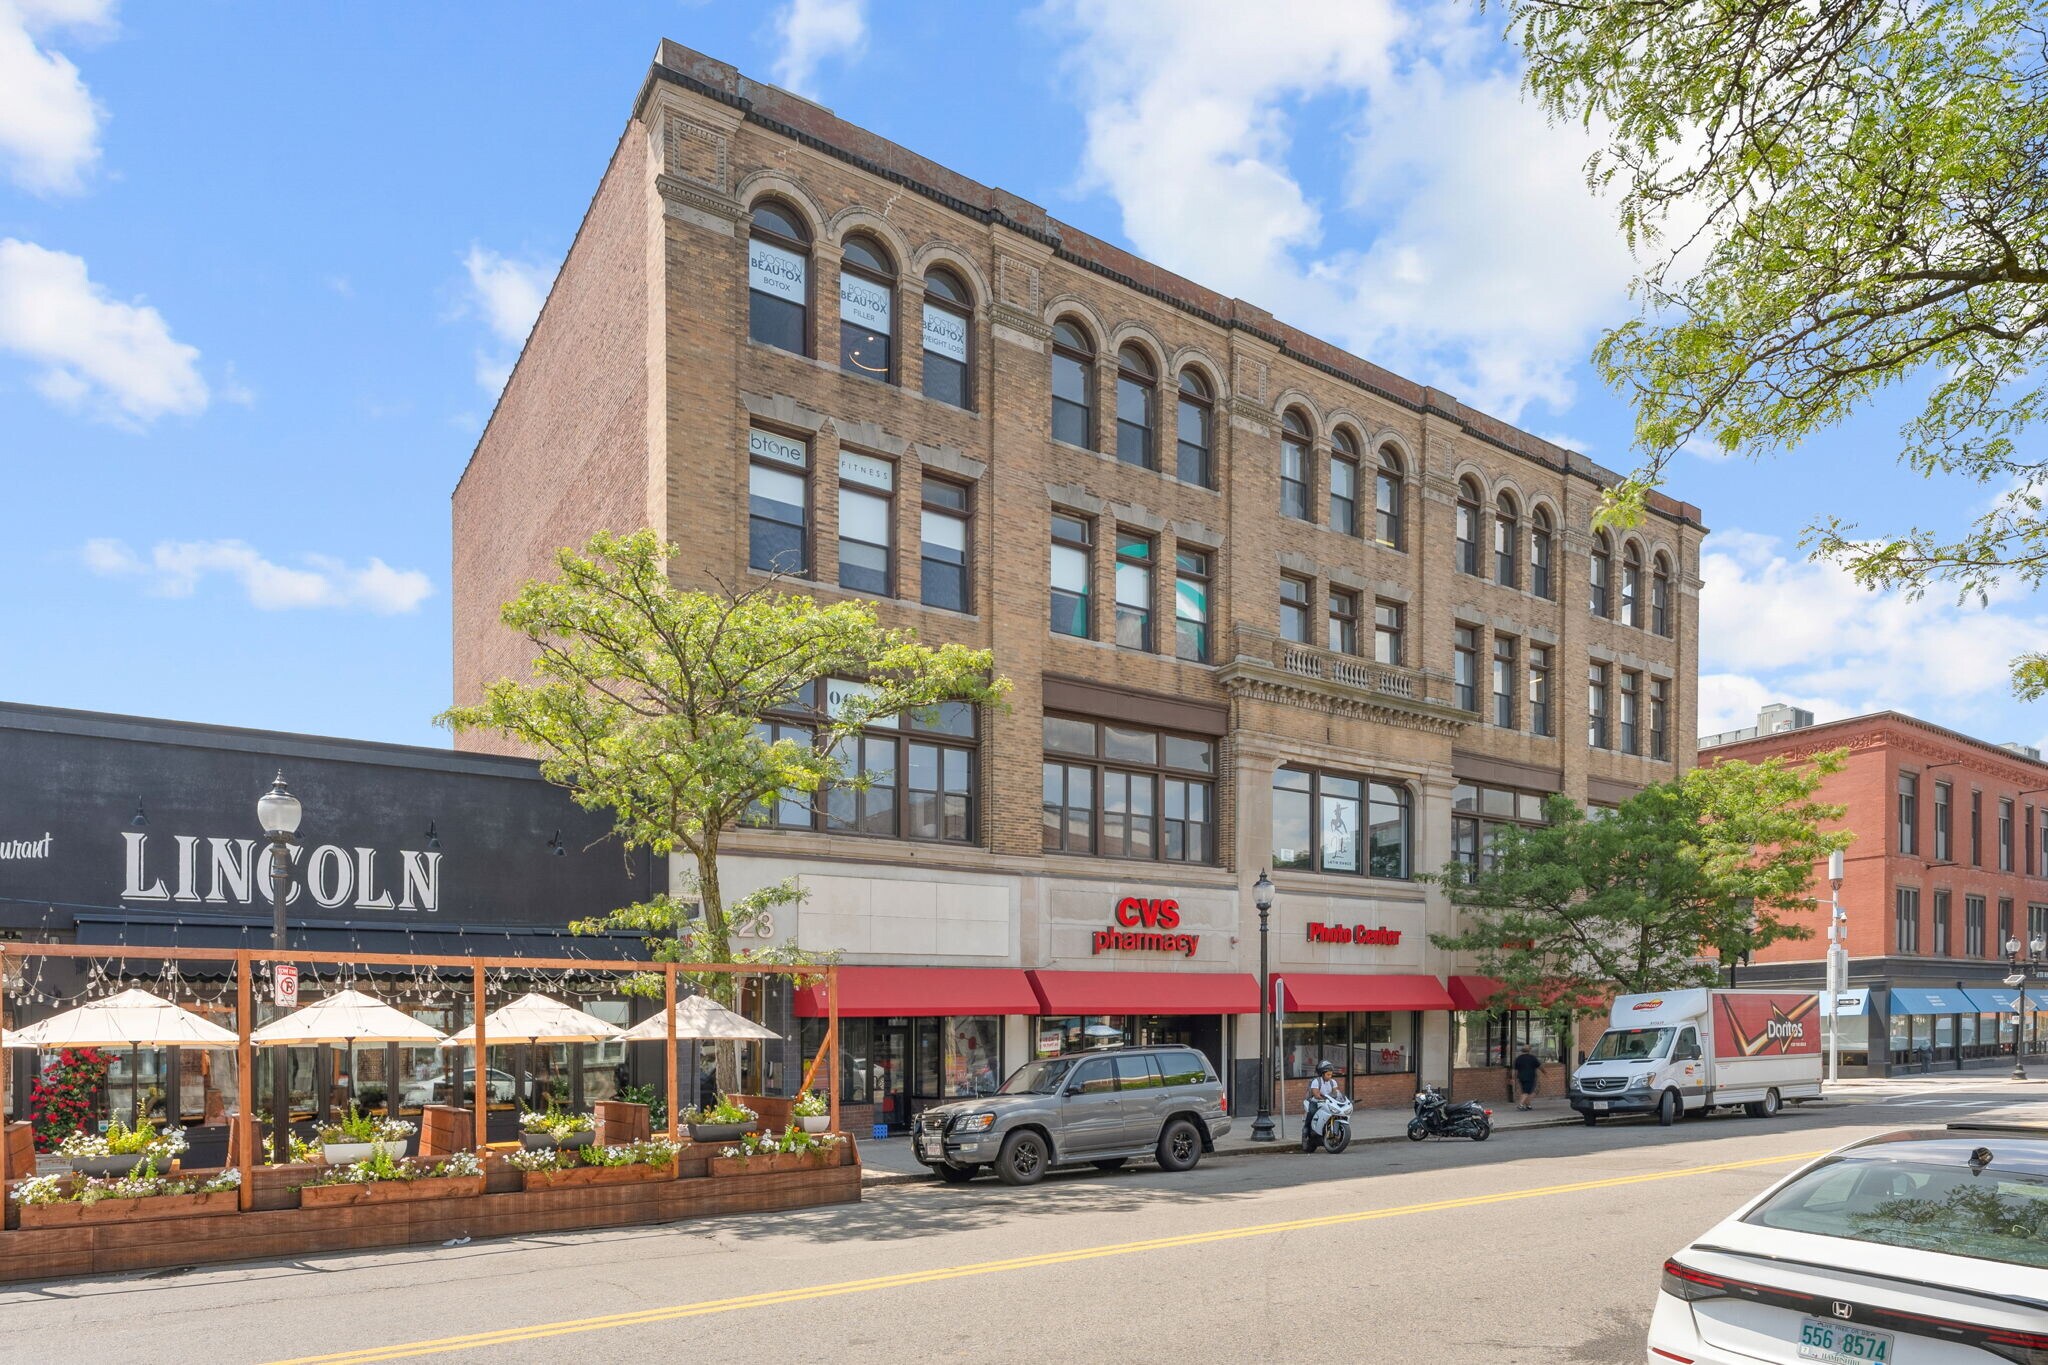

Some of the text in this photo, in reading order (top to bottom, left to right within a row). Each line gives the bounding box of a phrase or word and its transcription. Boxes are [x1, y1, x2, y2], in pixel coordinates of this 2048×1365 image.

[751, 257, 802, 284] BEAUTOX
[759, 251, 803, 274] BOSTON
[763, 276, 791, 292] BOTOX
[848, 283, 888, 305] BOSTON
[841, 290, 888, 315] BEAUTOX
[853, 308, 876, 322] FILLER
[923, 320, 964, 345] BEAUTOX
[948, 344, 964, 355] LOSS
[751, 433, 801, 460] btone
[841, 460, 889, 480] FITNESS
[0, 831, 54, 860] urant
[121, 832, 444, 912] LINCOLN
[1115, 897, 1181, 929] CVS
[1092, 926, 1200, 957] pharmacy
[1307, 922, 1401, 945] Photo Center
[1767, 1020, 1803, 1039] Doritos
[1802, 1325, 1887, 1361] 556 8574
